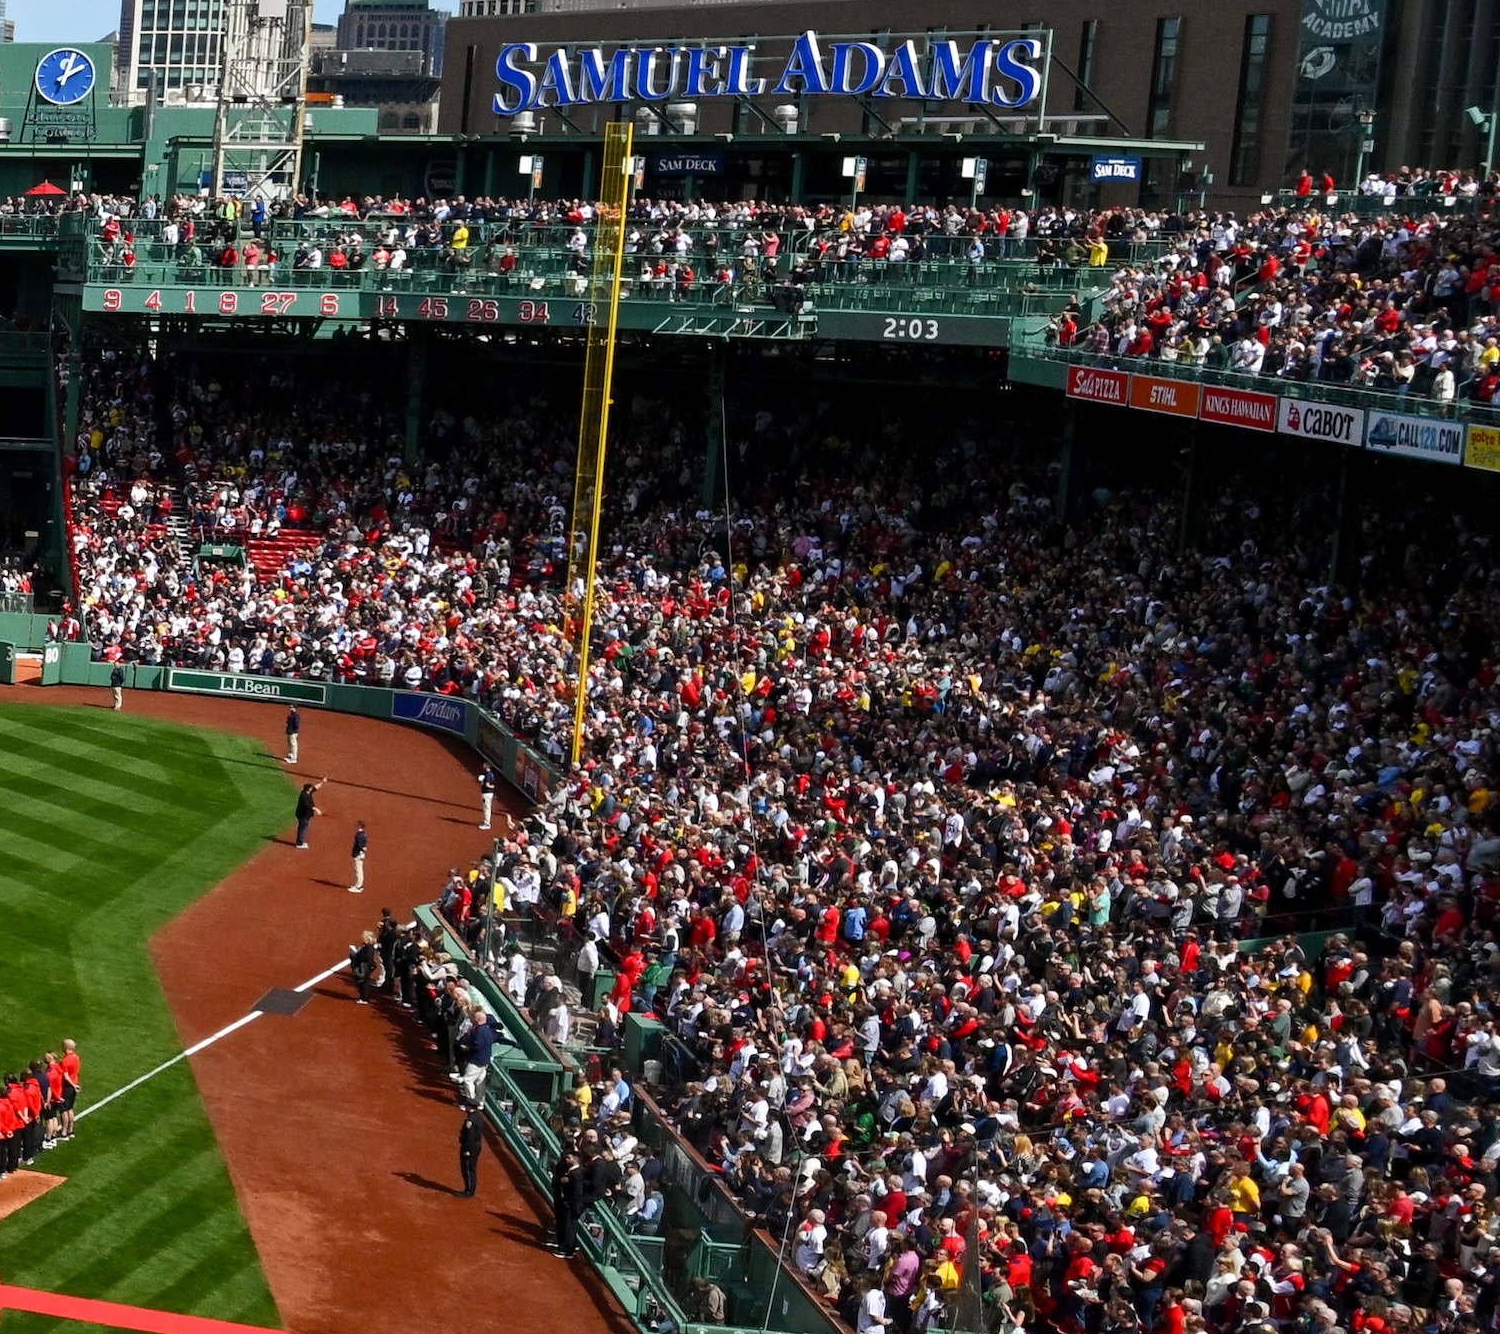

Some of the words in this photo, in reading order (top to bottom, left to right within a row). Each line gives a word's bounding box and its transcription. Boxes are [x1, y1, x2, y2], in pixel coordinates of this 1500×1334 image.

[1302, 11, 1379, 38] ACADEMY
[492, 42, 767, 116] SAMUEL
[772, 30, 1042, 109] ADAMS
[658, 158, 683, 172] SAM
[685, 157, 717, 172] DECK
[1094, 163, 1112, 179] SAM
[1113, 164, 1136, 179] DECK
[104, 290, 122, 310] 9
[145, 290, 161, 311] 4
[185, 291, 196, 312] 1
[219, 292, 238, 313] 8
[261, 292, 297, 314] 27
[320, 293, 339, 315] 6
[376, 295, 398, 317] 14
[418, 297, 448, 319] 45
[468, 299, 499, 322] 26
[518, 301, 549, 324] 34
[571, 302, 597, 325] 42
[883, 317, 939, 340] 2:03
[1094, 377, 1120, 399] PIZZA
[1150, 385, 1177, 407] STIHL
[1205, 394, 1230, 415] KING'S
[1231, 402, 1272, 422] HAWAIIAN
[1398, 422, 1461, 455] CALL128.COM
[45, 648, 58, 664] 80
[417, 697, 461, 723] Jordan's
